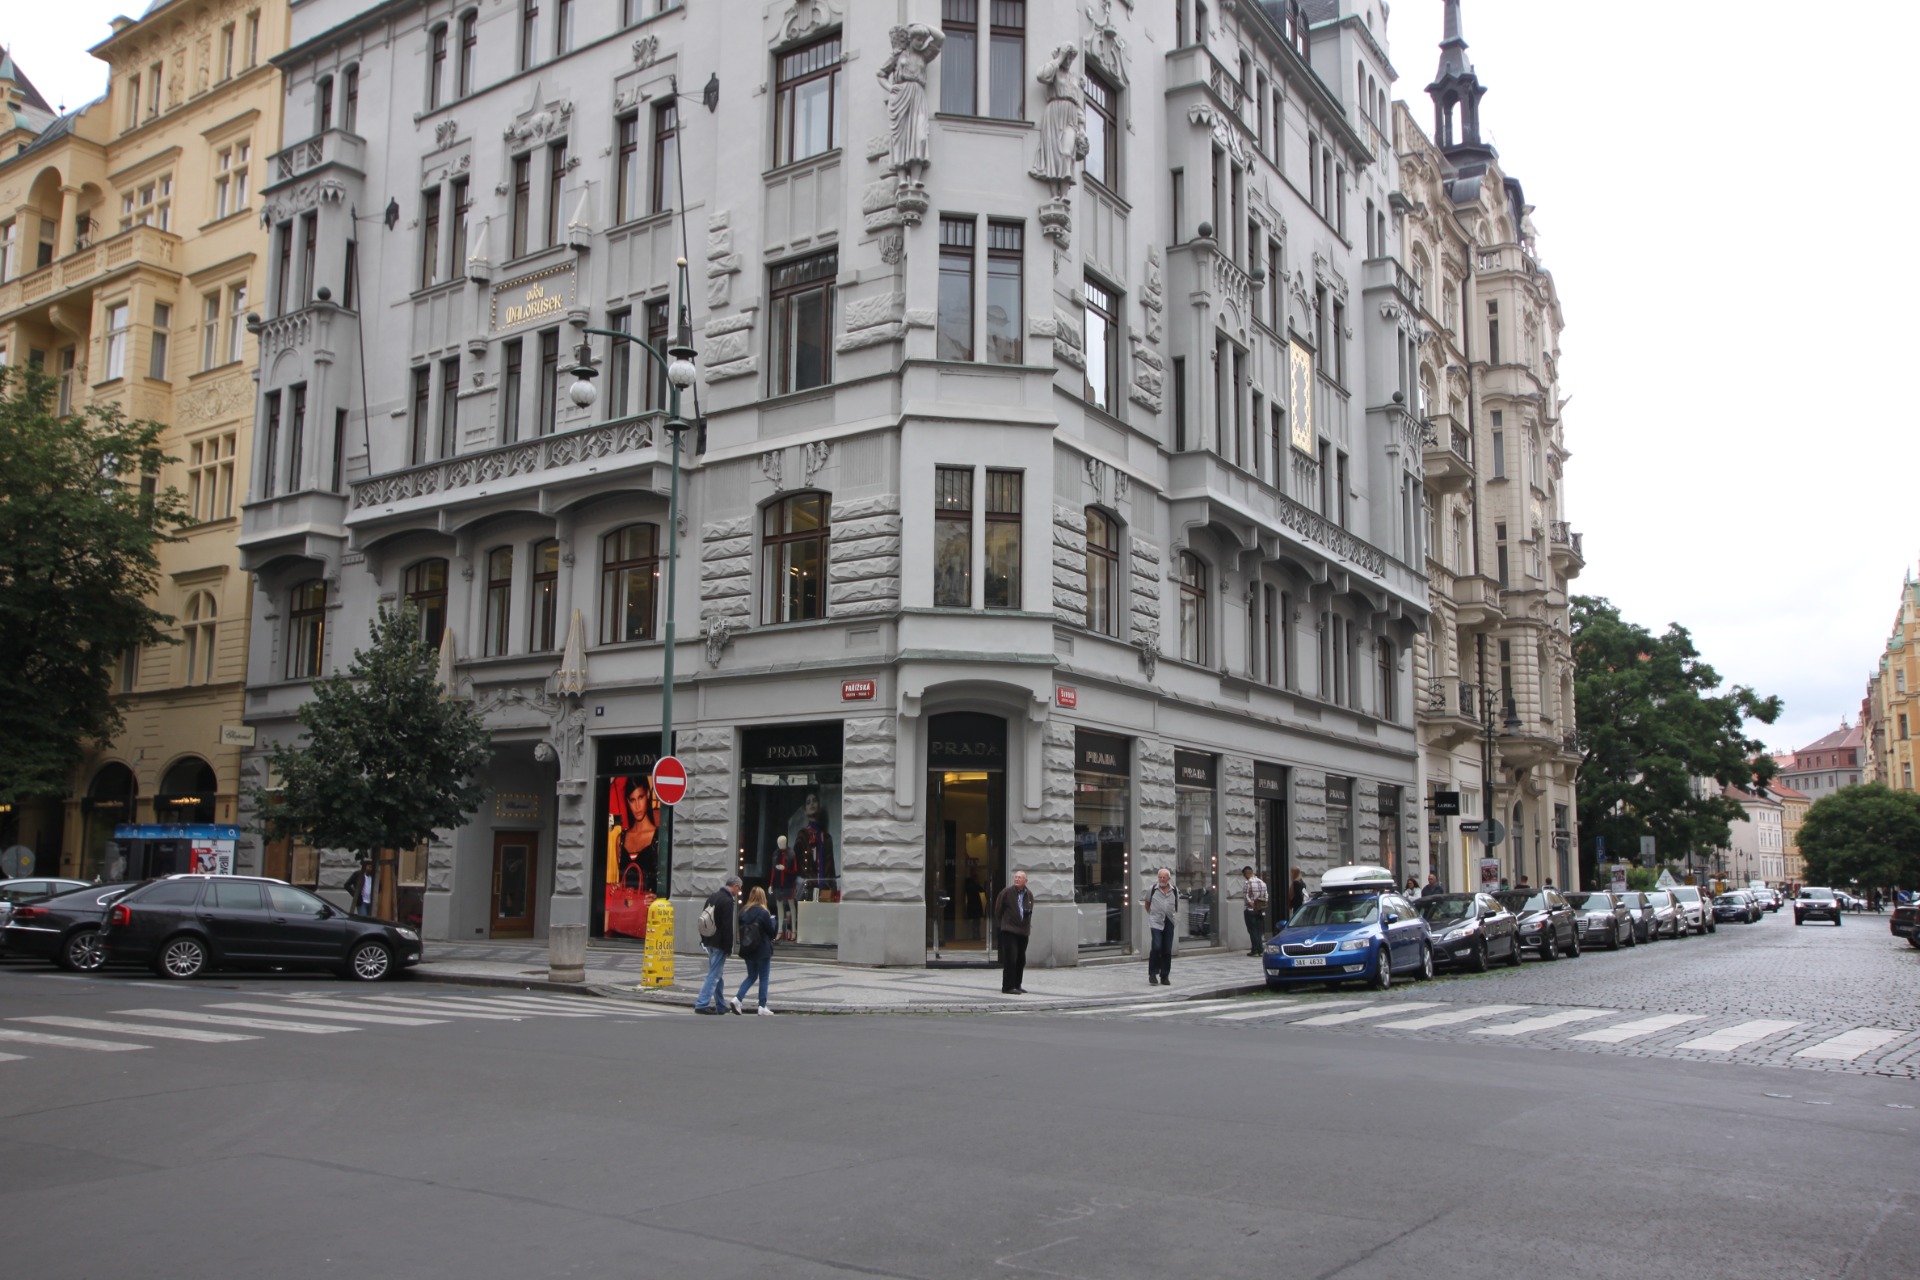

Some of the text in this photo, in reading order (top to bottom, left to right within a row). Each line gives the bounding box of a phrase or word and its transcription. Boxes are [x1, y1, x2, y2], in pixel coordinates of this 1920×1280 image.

[768, 744, 818, 759] PRADA
[931, 741, 1001, 757] PRADA
[616, 753, 658, 766] PRADA
[1086, 751, 1116, 766] PRADA
